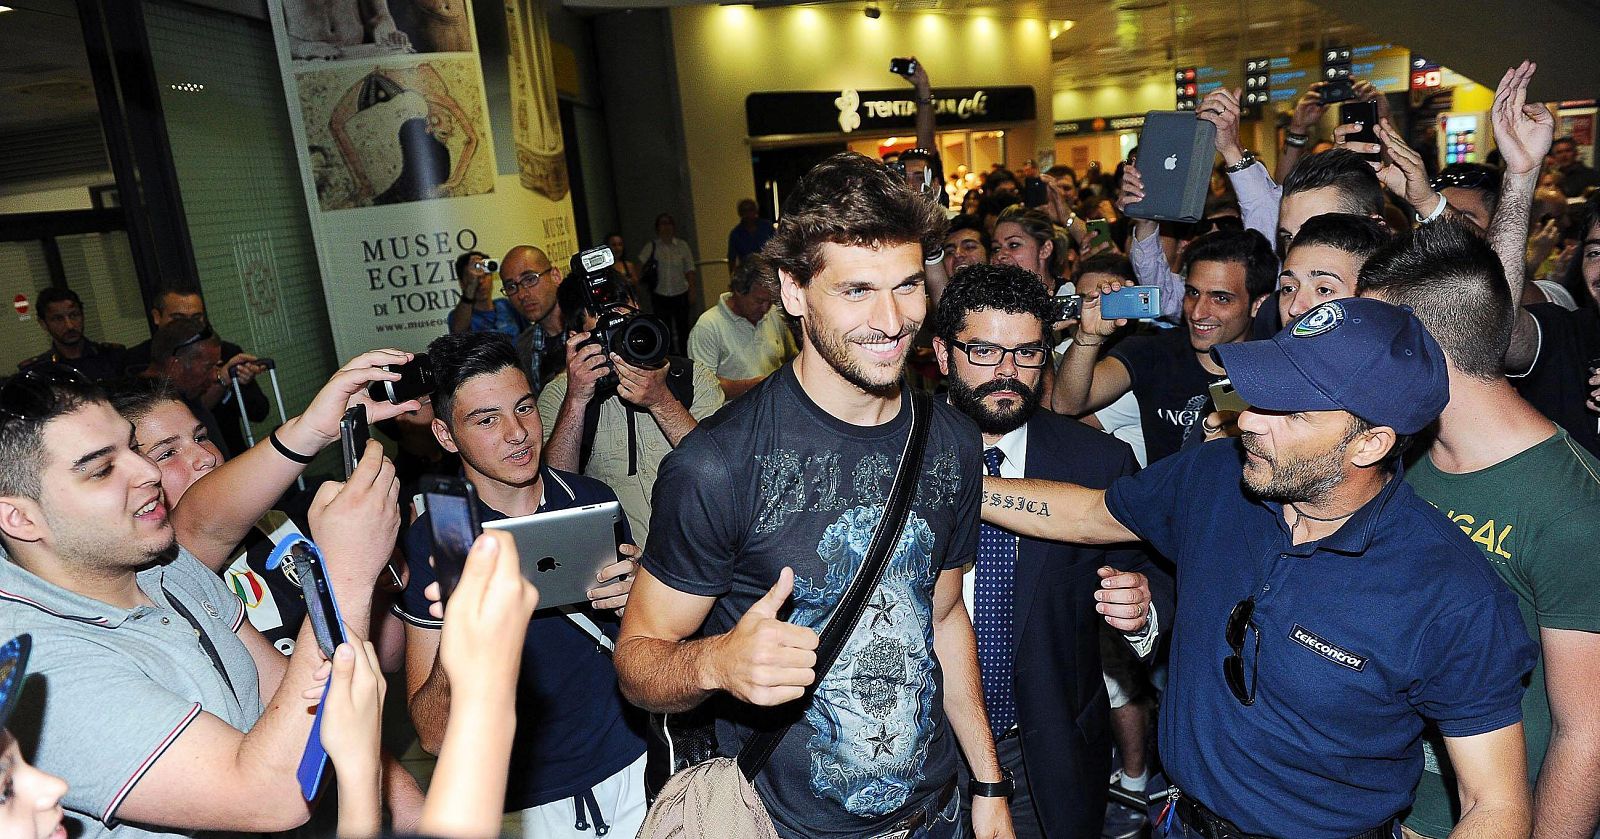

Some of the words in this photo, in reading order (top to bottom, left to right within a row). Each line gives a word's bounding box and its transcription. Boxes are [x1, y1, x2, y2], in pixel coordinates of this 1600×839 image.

[360, 228, 477, 263] MUSEO
[366, 260, 459, 291] EGIZI
[373, 303, 388, 316] DI
[391, 289, 463, 314] TORIN
[981, 490, 1052, 517] ESSICA
[1294, 629, 1362, 668] telecontrol
